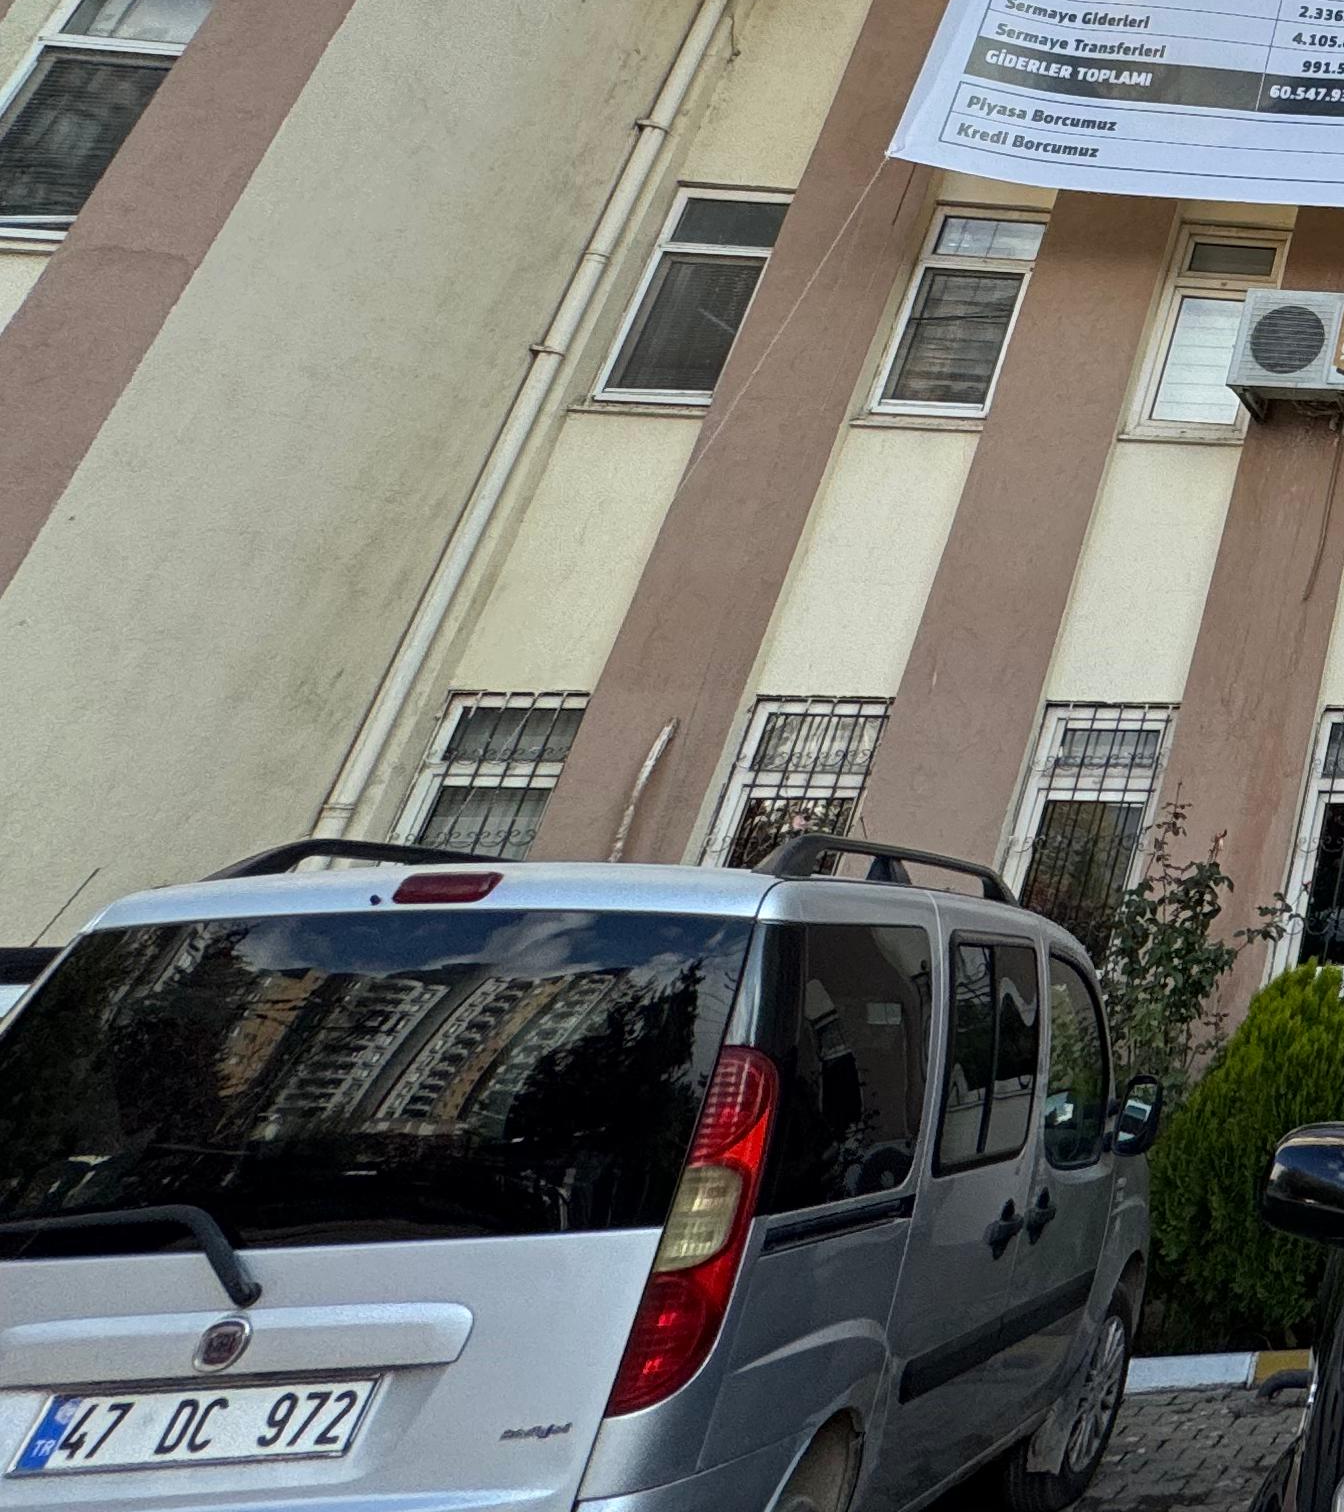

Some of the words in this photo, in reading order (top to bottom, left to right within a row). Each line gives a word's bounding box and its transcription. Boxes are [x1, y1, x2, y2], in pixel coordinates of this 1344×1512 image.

[1082, 12, 1150, 29] Giderleri
[996, 22, 1068, 50] Sermaye
[1074, 39, 1166, 58] Transferleri
[985, 49, 1072, 78] GİDERLER
[1077, 67, 1153, 86] TOPLAMI
[967, 95, 1027, 120] Piyasa
[1031, 110, 1117, 132] Borcumuz
[957, 122, 1008, 145] Kredi
[1012, 135, 1099, 158] Borcumuz
[32, 1439, 56, 1455] TR
[59, 1402, 134, 1459] 47
[155, 1397, 229, 1455] DC
[257, 1389, 359, 1448] 972
